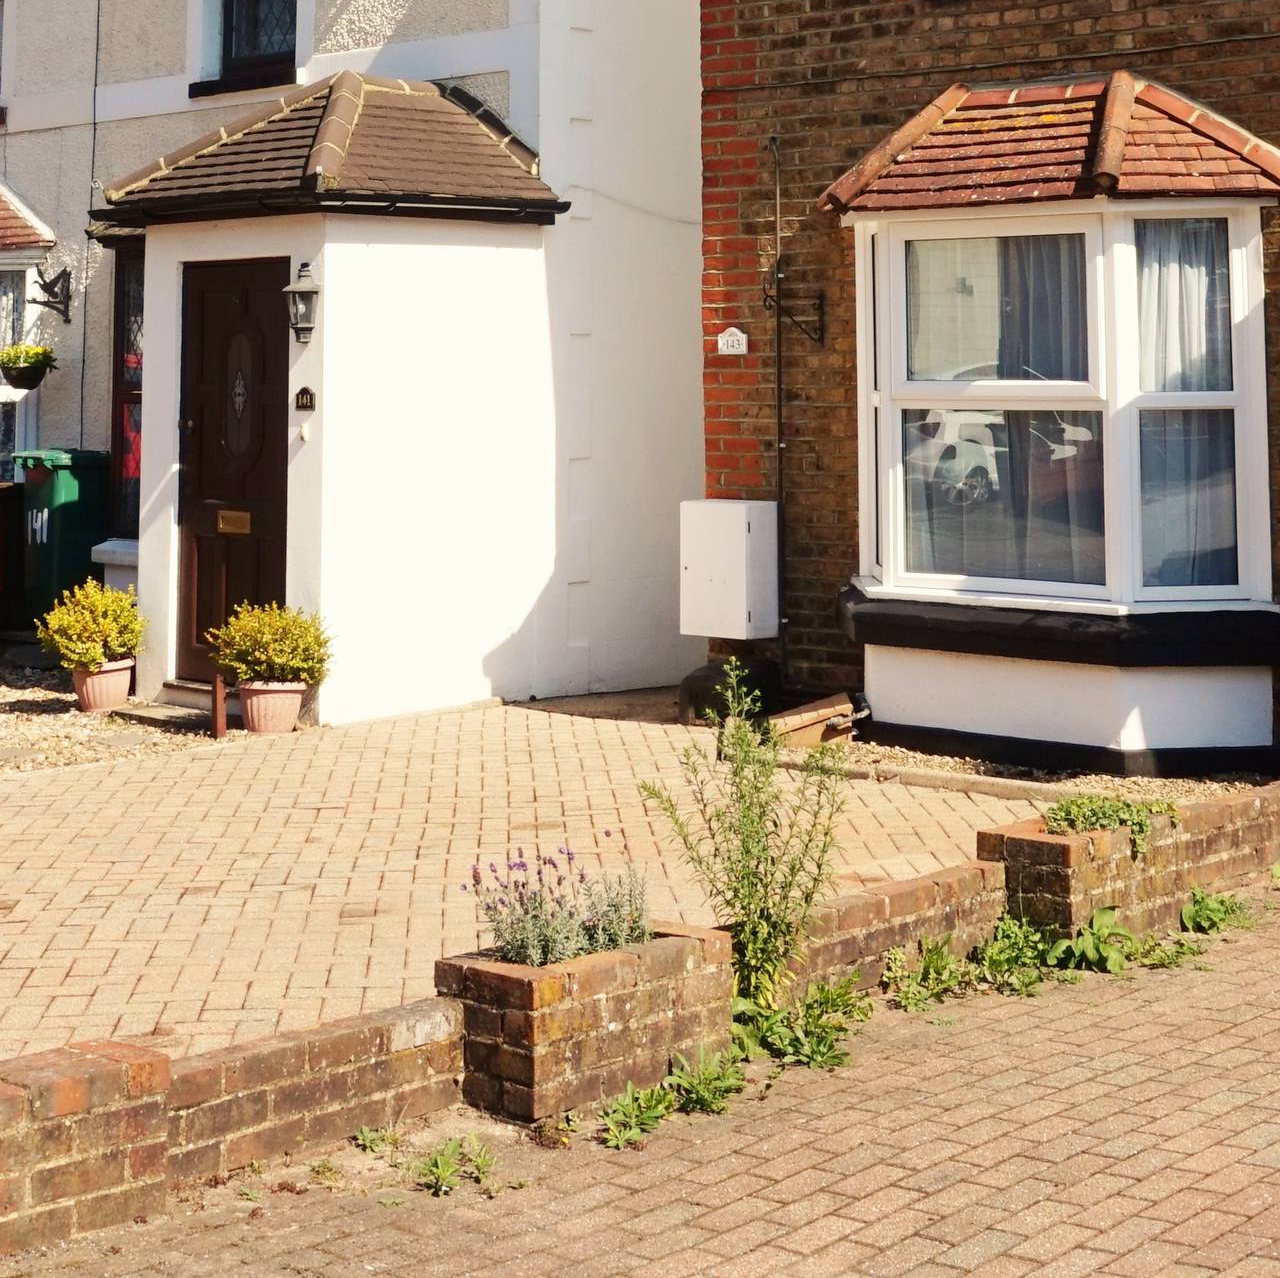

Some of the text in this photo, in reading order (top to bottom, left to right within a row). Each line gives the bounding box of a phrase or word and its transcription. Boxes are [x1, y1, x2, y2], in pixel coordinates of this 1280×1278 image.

[726, 339, 741, 350] 143
[298, 394, 311, 406] 141
[27, 507, 49, 545] 141
